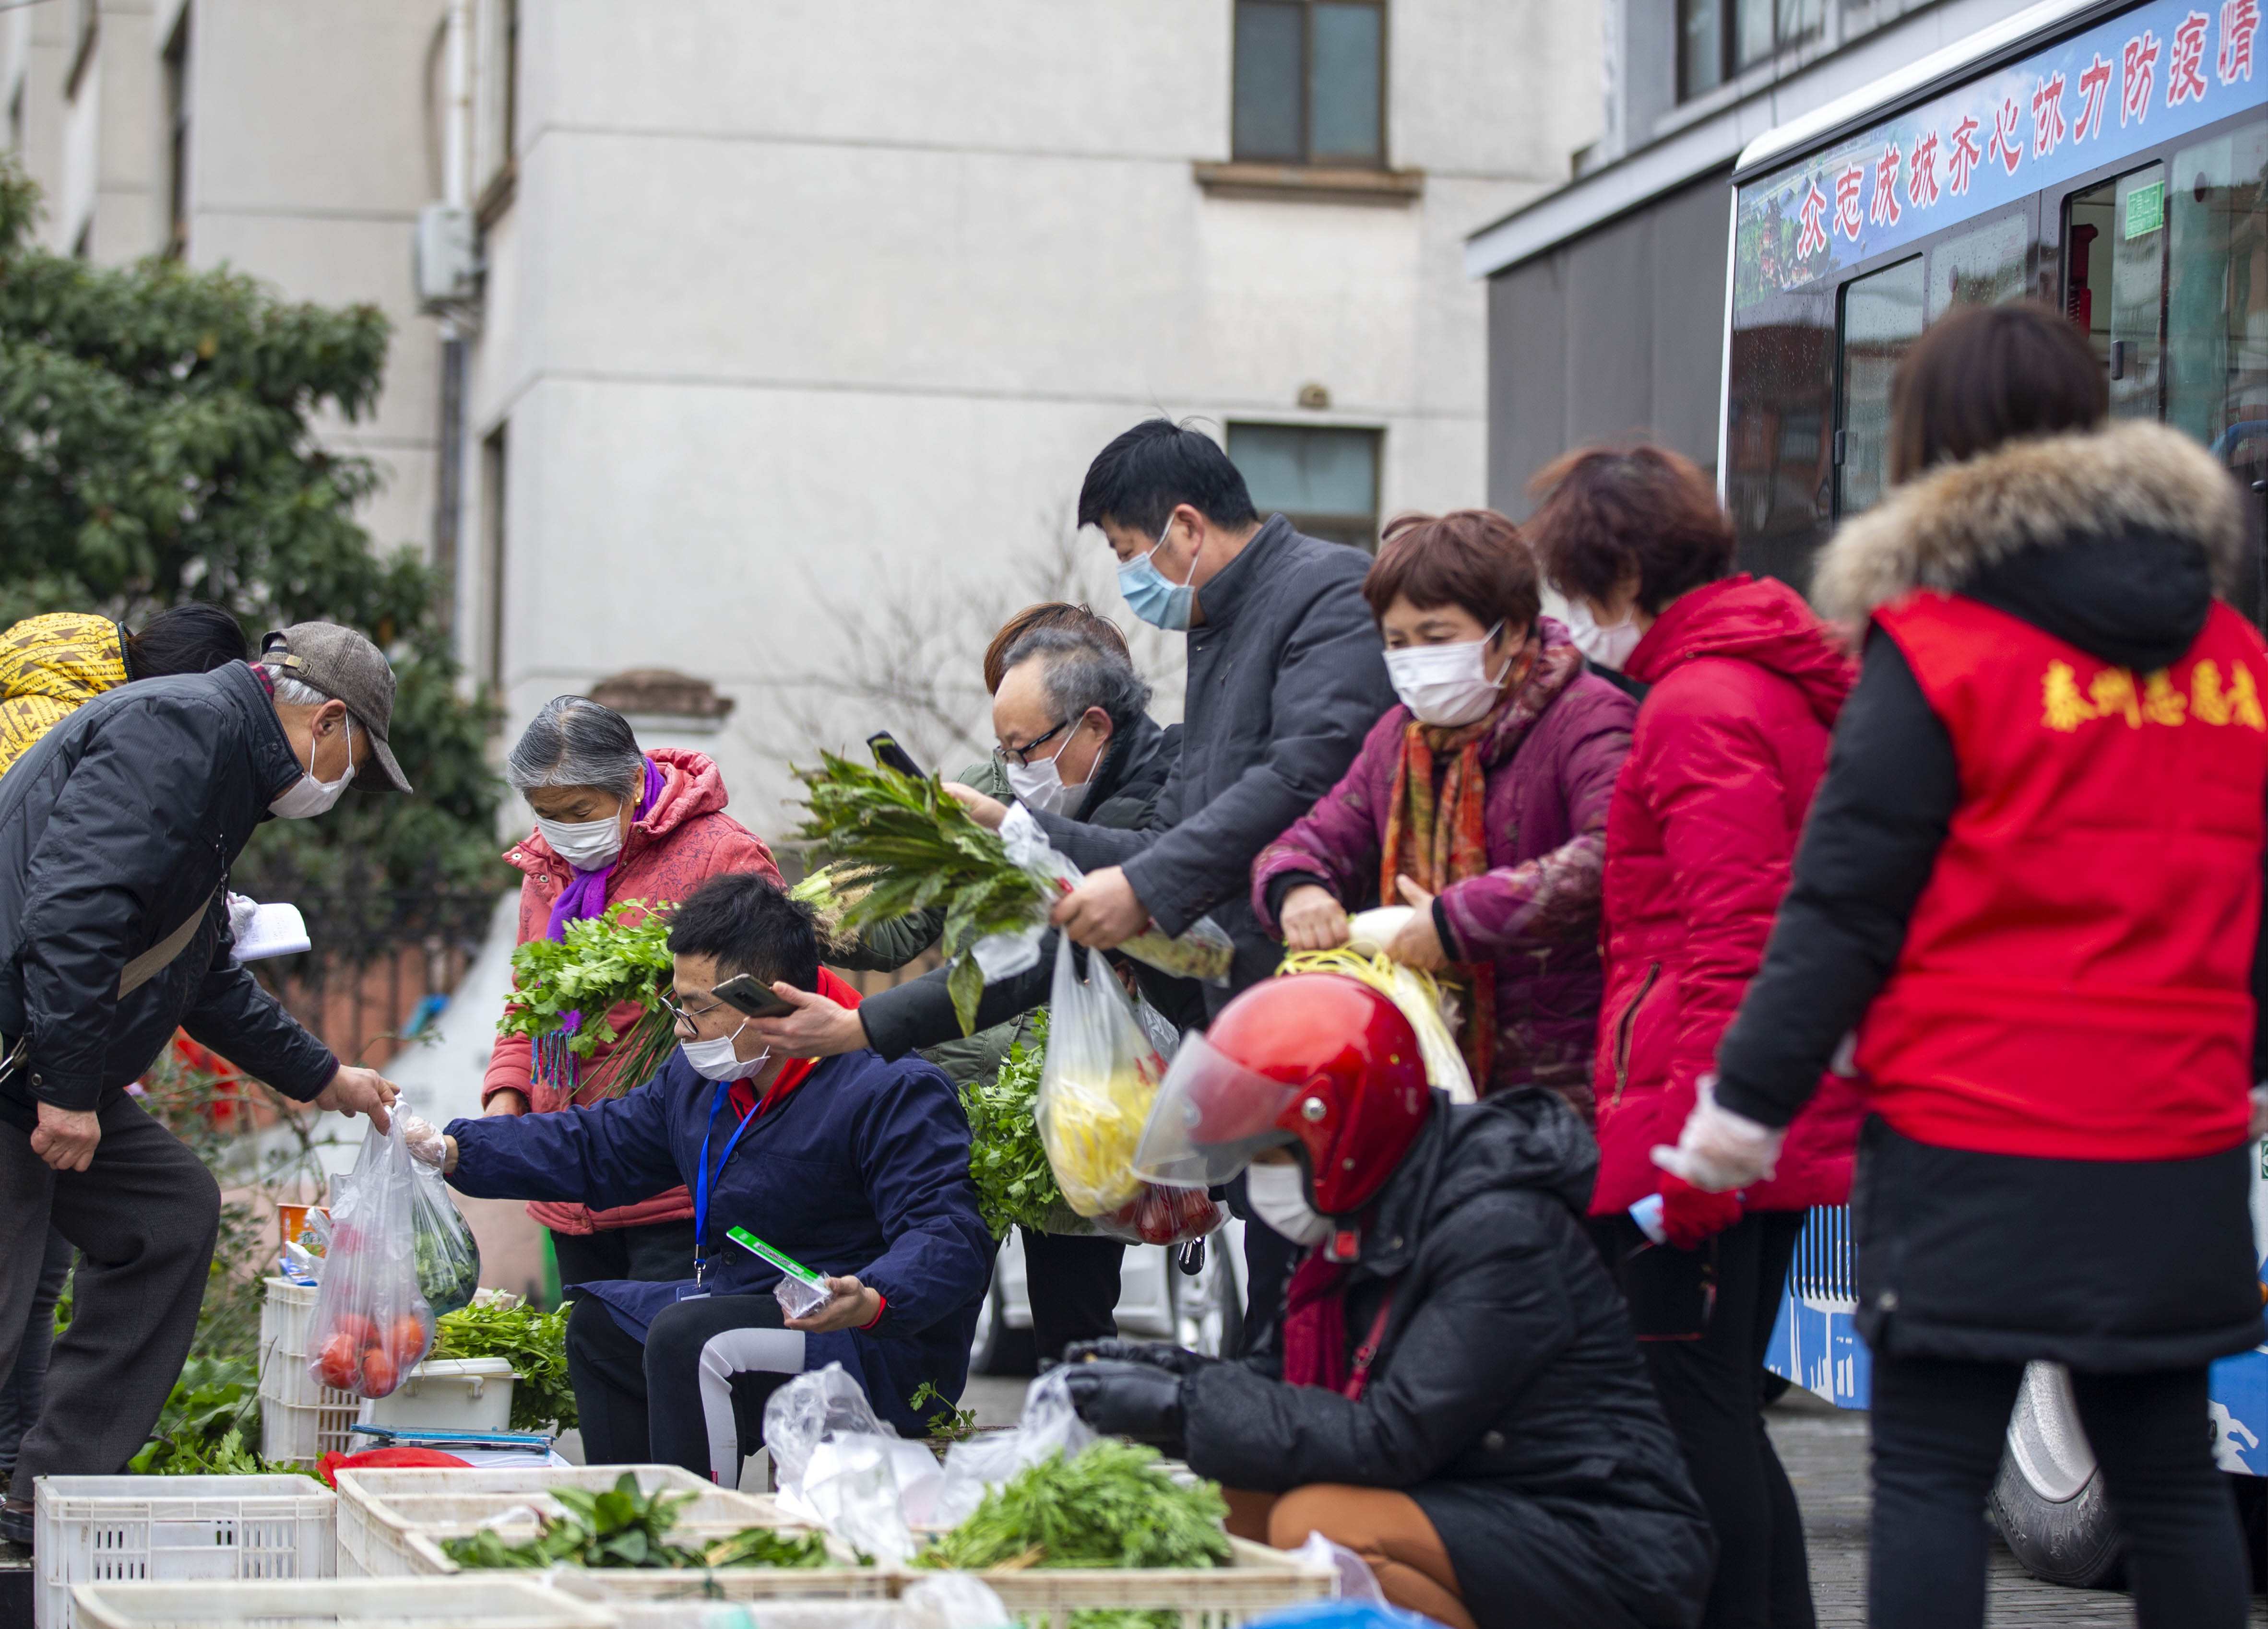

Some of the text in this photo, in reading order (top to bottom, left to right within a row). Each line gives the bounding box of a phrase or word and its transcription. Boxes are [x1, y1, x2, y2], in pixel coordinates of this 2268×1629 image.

[1797, 0, 2260, 260] 众志成城齐心协力防疫情
